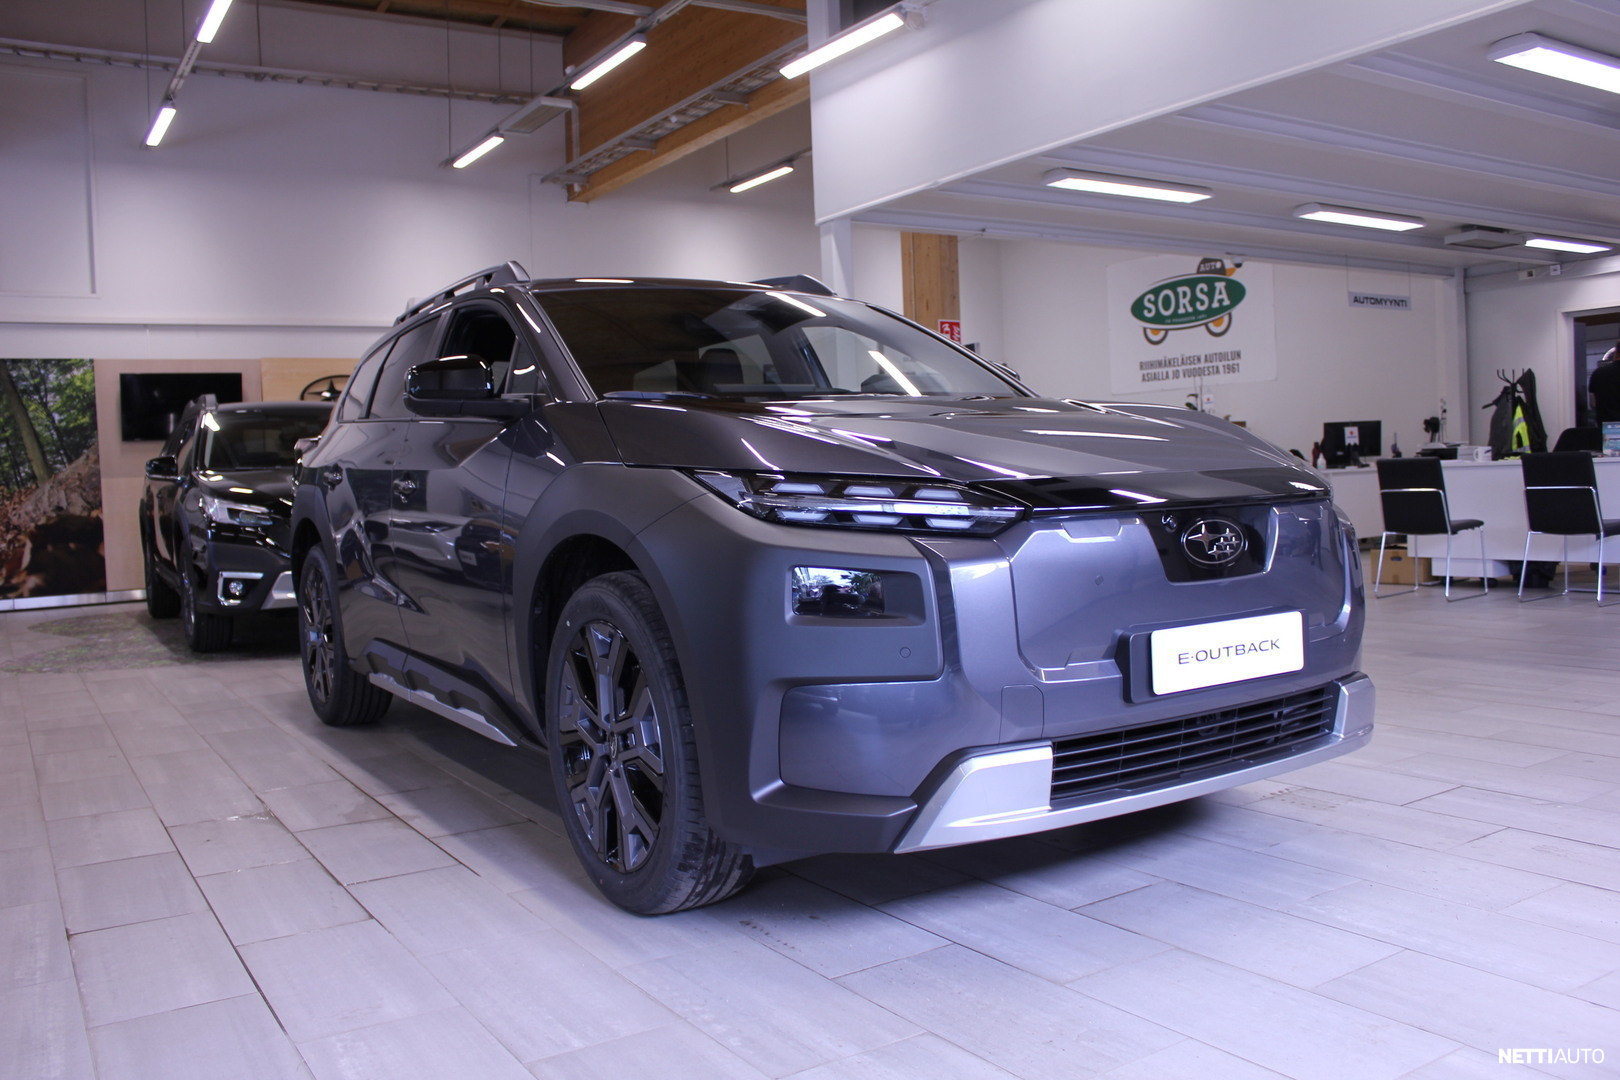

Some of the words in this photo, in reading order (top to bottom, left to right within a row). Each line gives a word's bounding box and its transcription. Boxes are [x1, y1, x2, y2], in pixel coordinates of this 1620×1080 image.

[1143, 281, 1231, 318] SORSA
[1353, 295, 1408, 308] AUTOMYYNTI
[1204, 350, 1242, 364] AUTOILUN
[1142, 370, 1170, 382] ASIALLA
[1172, 368, 1181, 380] JO
[1182, 364, 1221, 379] VUODESTA
[1222, 363, 1240, 375] 1961
